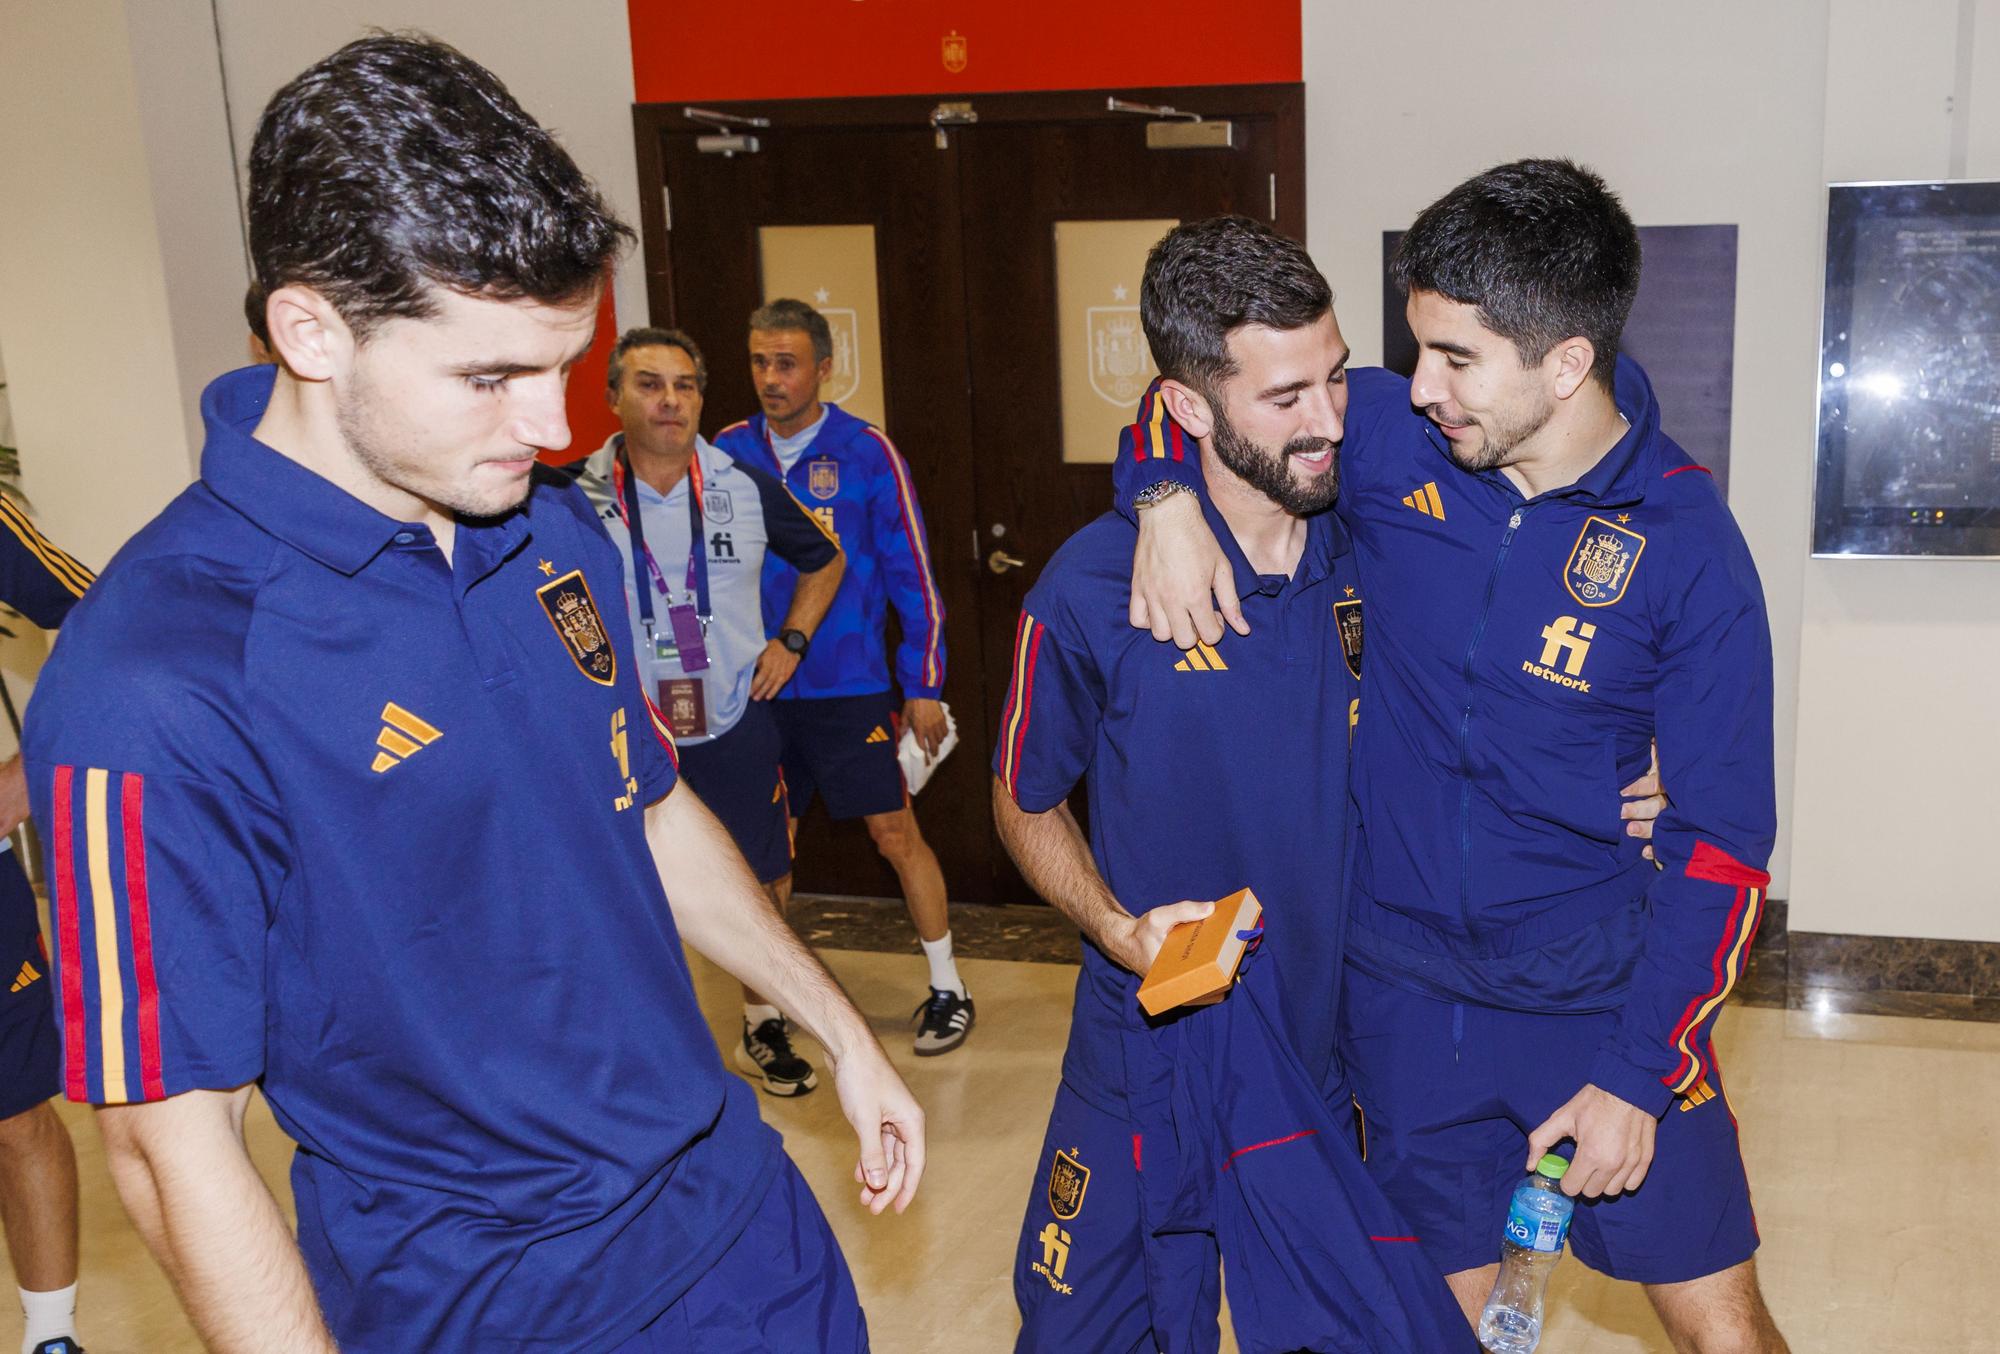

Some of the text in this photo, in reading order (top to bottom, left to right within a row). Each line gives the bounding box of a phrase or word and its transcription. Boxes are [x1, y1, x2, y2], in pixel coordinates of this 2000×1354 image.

[710, 532, 735, 557] fi
[1540, 615, 1597, 677] fi
[1522, 660, 1591, 693] network
[1039, 1223, 1072, 1280] fi
